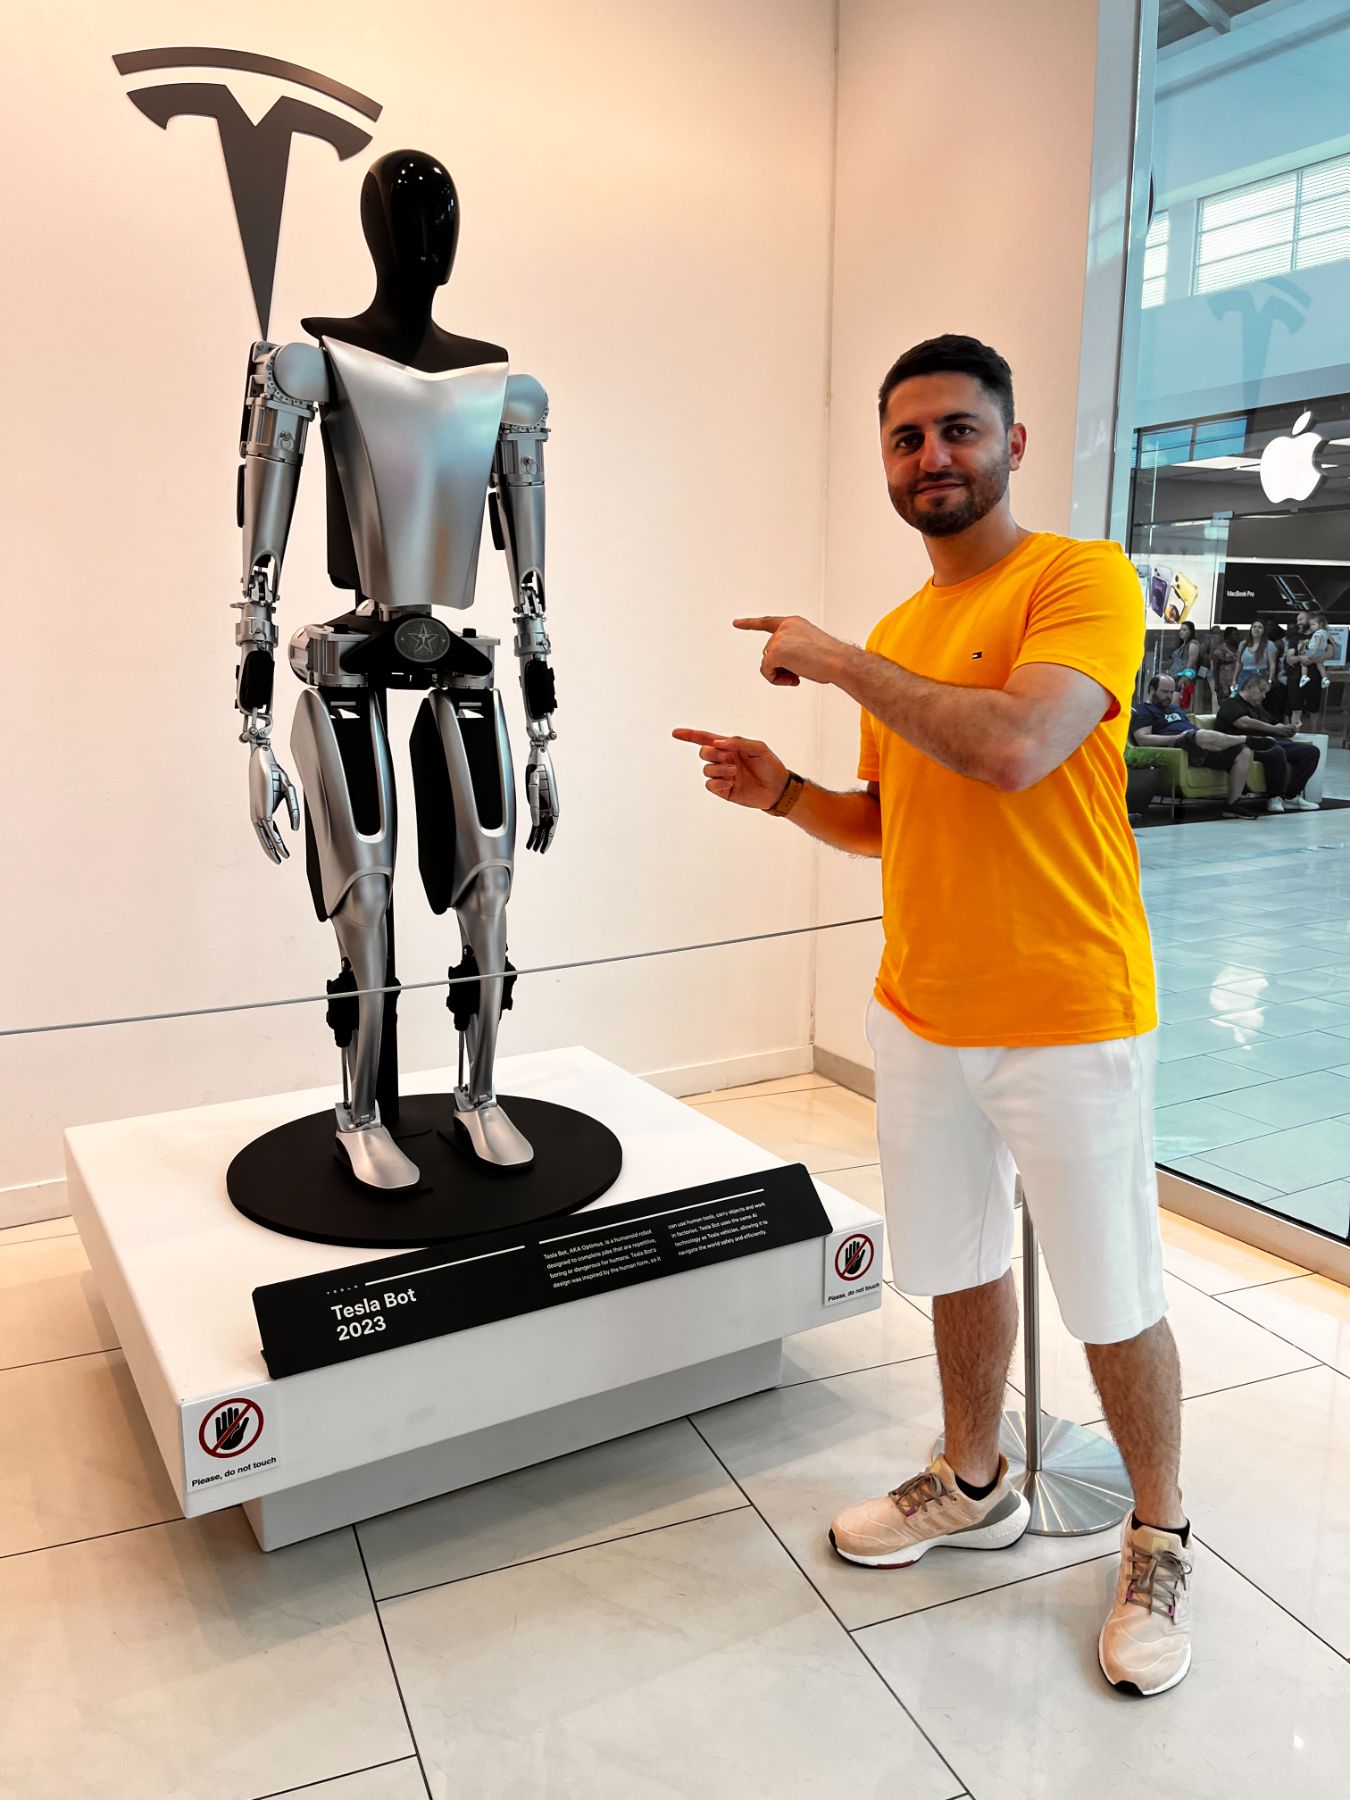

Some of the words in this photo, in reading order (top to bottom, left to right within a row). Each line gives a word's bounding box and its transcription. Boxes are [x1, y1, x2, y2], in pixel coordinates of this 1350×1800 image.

[864, 1283, 880, 1291] touch
[330, 1298, 381, 1320] Tesla
[383, 1288, 417, 1308] Bot
[336, 1315, 386, 1341] 2023
[192, 1474, 223, 1487] Please,
[224, 1469, 235, 1477] do
[237, 1464, 251, 1473] not
[253, 1457, 277, 1468] touch
